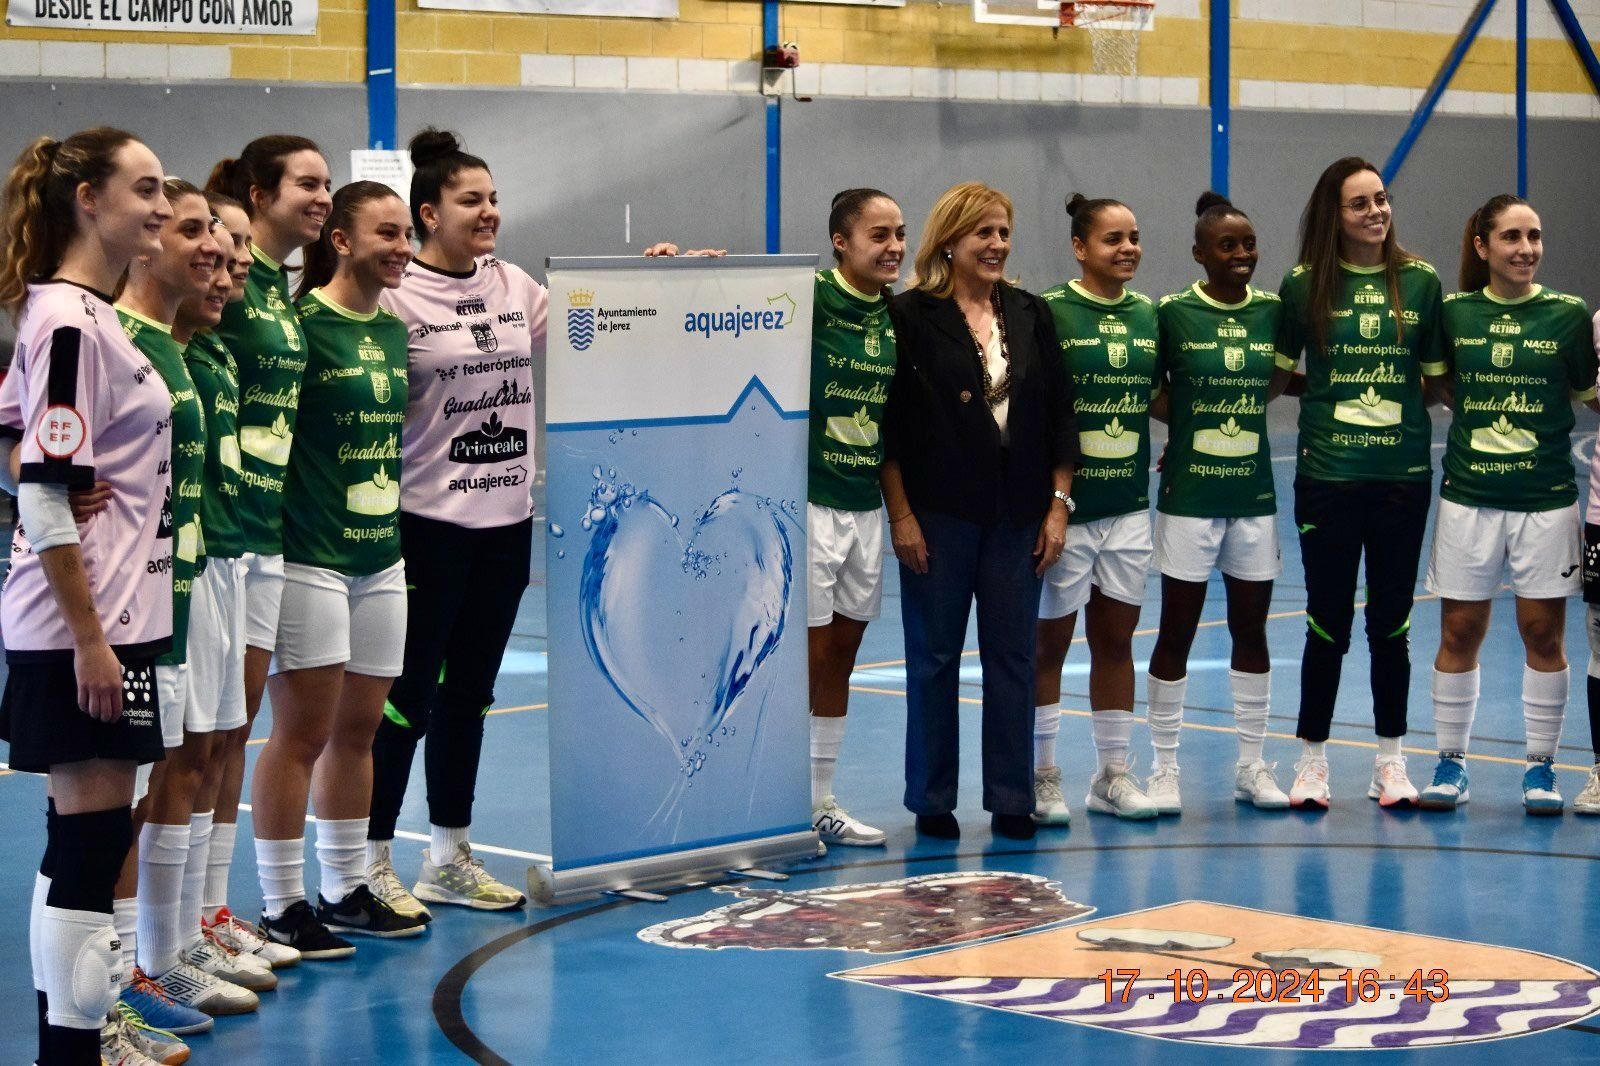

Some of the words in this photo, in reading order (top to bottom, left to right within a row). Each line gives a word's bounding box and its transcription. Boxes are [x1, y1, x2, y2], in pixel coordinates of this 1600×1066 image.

[35, 0, 93, 19] DESDE
[100, 0, 122, 21] EL
[128, 0, 193, 23] CAMPO
[199, 0, 235, 25] CON
[241, 0, 293, 26] AMOR
[1354, 294, 1385, 305] RETIRO
[456, 303, 487, 317] RETIRO
[598, 307, 657, 319] Ayuntamiento
[1388, 310, 1419, 321] NCEX
[498, 312, 525, 324] NACEX
[685, 305, 784, 338] aquajerez
[597, 321, 608, 331] de
[609, 321, 631, 333] Jerez
[1098, 324, 1128, 335] RETIRO
[1217, 327, 1248, 338] RETIRO
[1489, 324, 1522, 335] RETIRO
[1343, 344, 1411, 357] federópticos
[1522, 339, 1559, 350] NACEX
[359, 349, 386, 362] RETIRO
[463, 357, 531, 375] federóptico
[850, 358, 897, 376] federóptic
[1475, 372, 1548, 386] federópticos
[360, 410, 405, 425] federópti
[454, 435, 525, 457] Primeale
[1332, 432, 1396, 447] aquajerez
[1189, 463, 1251, 479] aquajerez
[1470, 460, 1533, 474] aquajerez
[448, 473, 519, 493] aquajerez
